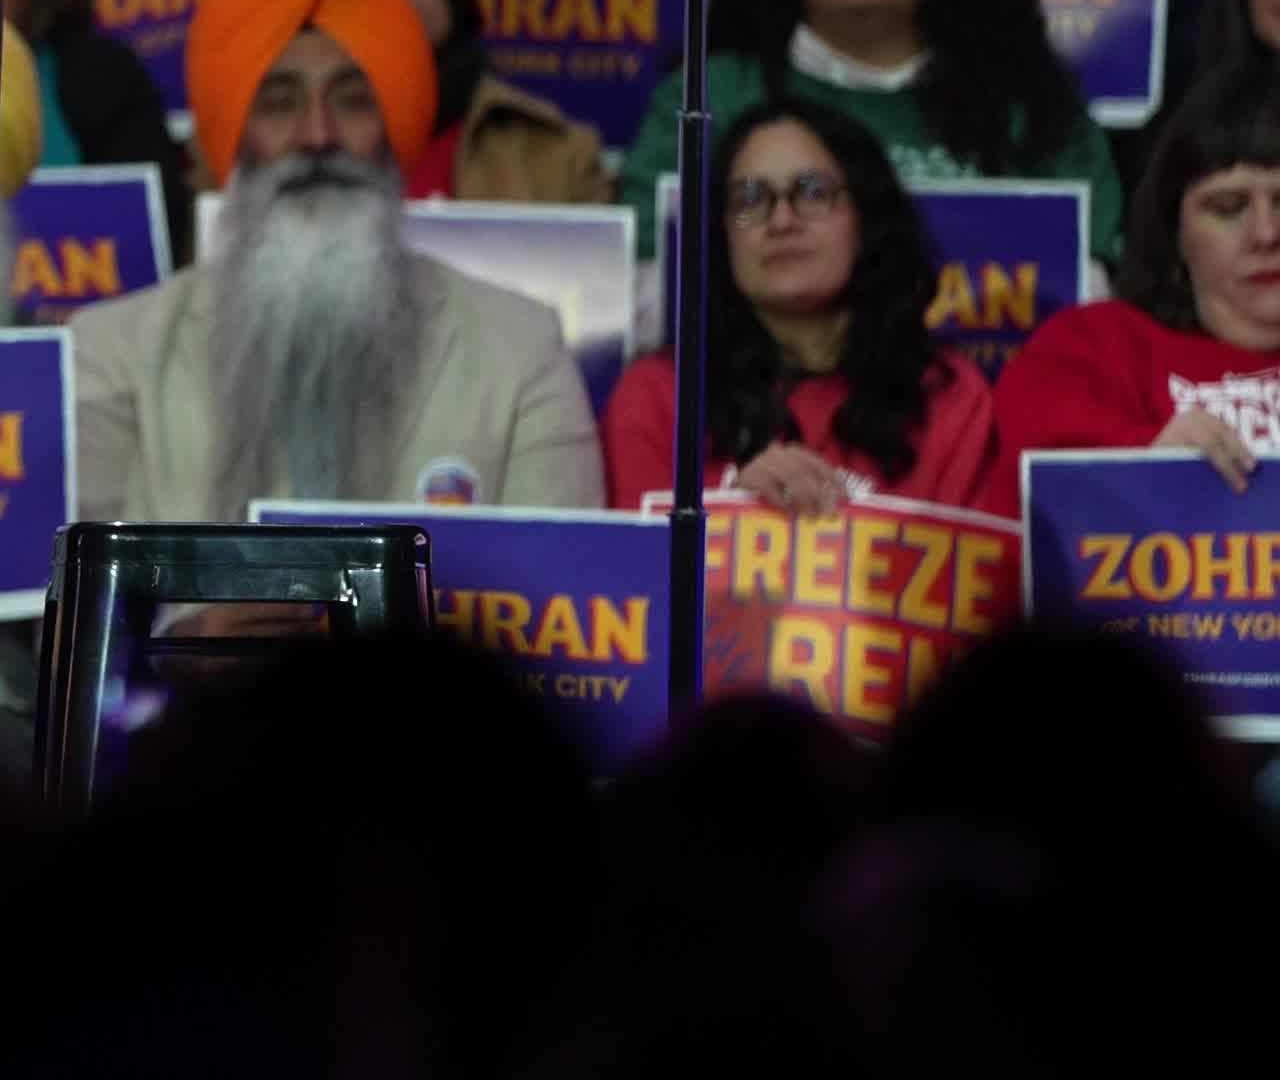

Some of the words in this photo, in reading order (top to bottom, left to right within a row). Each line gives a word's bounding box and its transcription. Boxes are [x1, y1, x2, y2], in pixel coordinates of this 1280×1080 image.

[433, 588, 651, 665] HRAN
[1146, 611, 1225, 643] NEW
[1230, 609, 1280, 643] YO
[552, 672, 631, 705] CITY
[768, 614, 937, 724] RE
